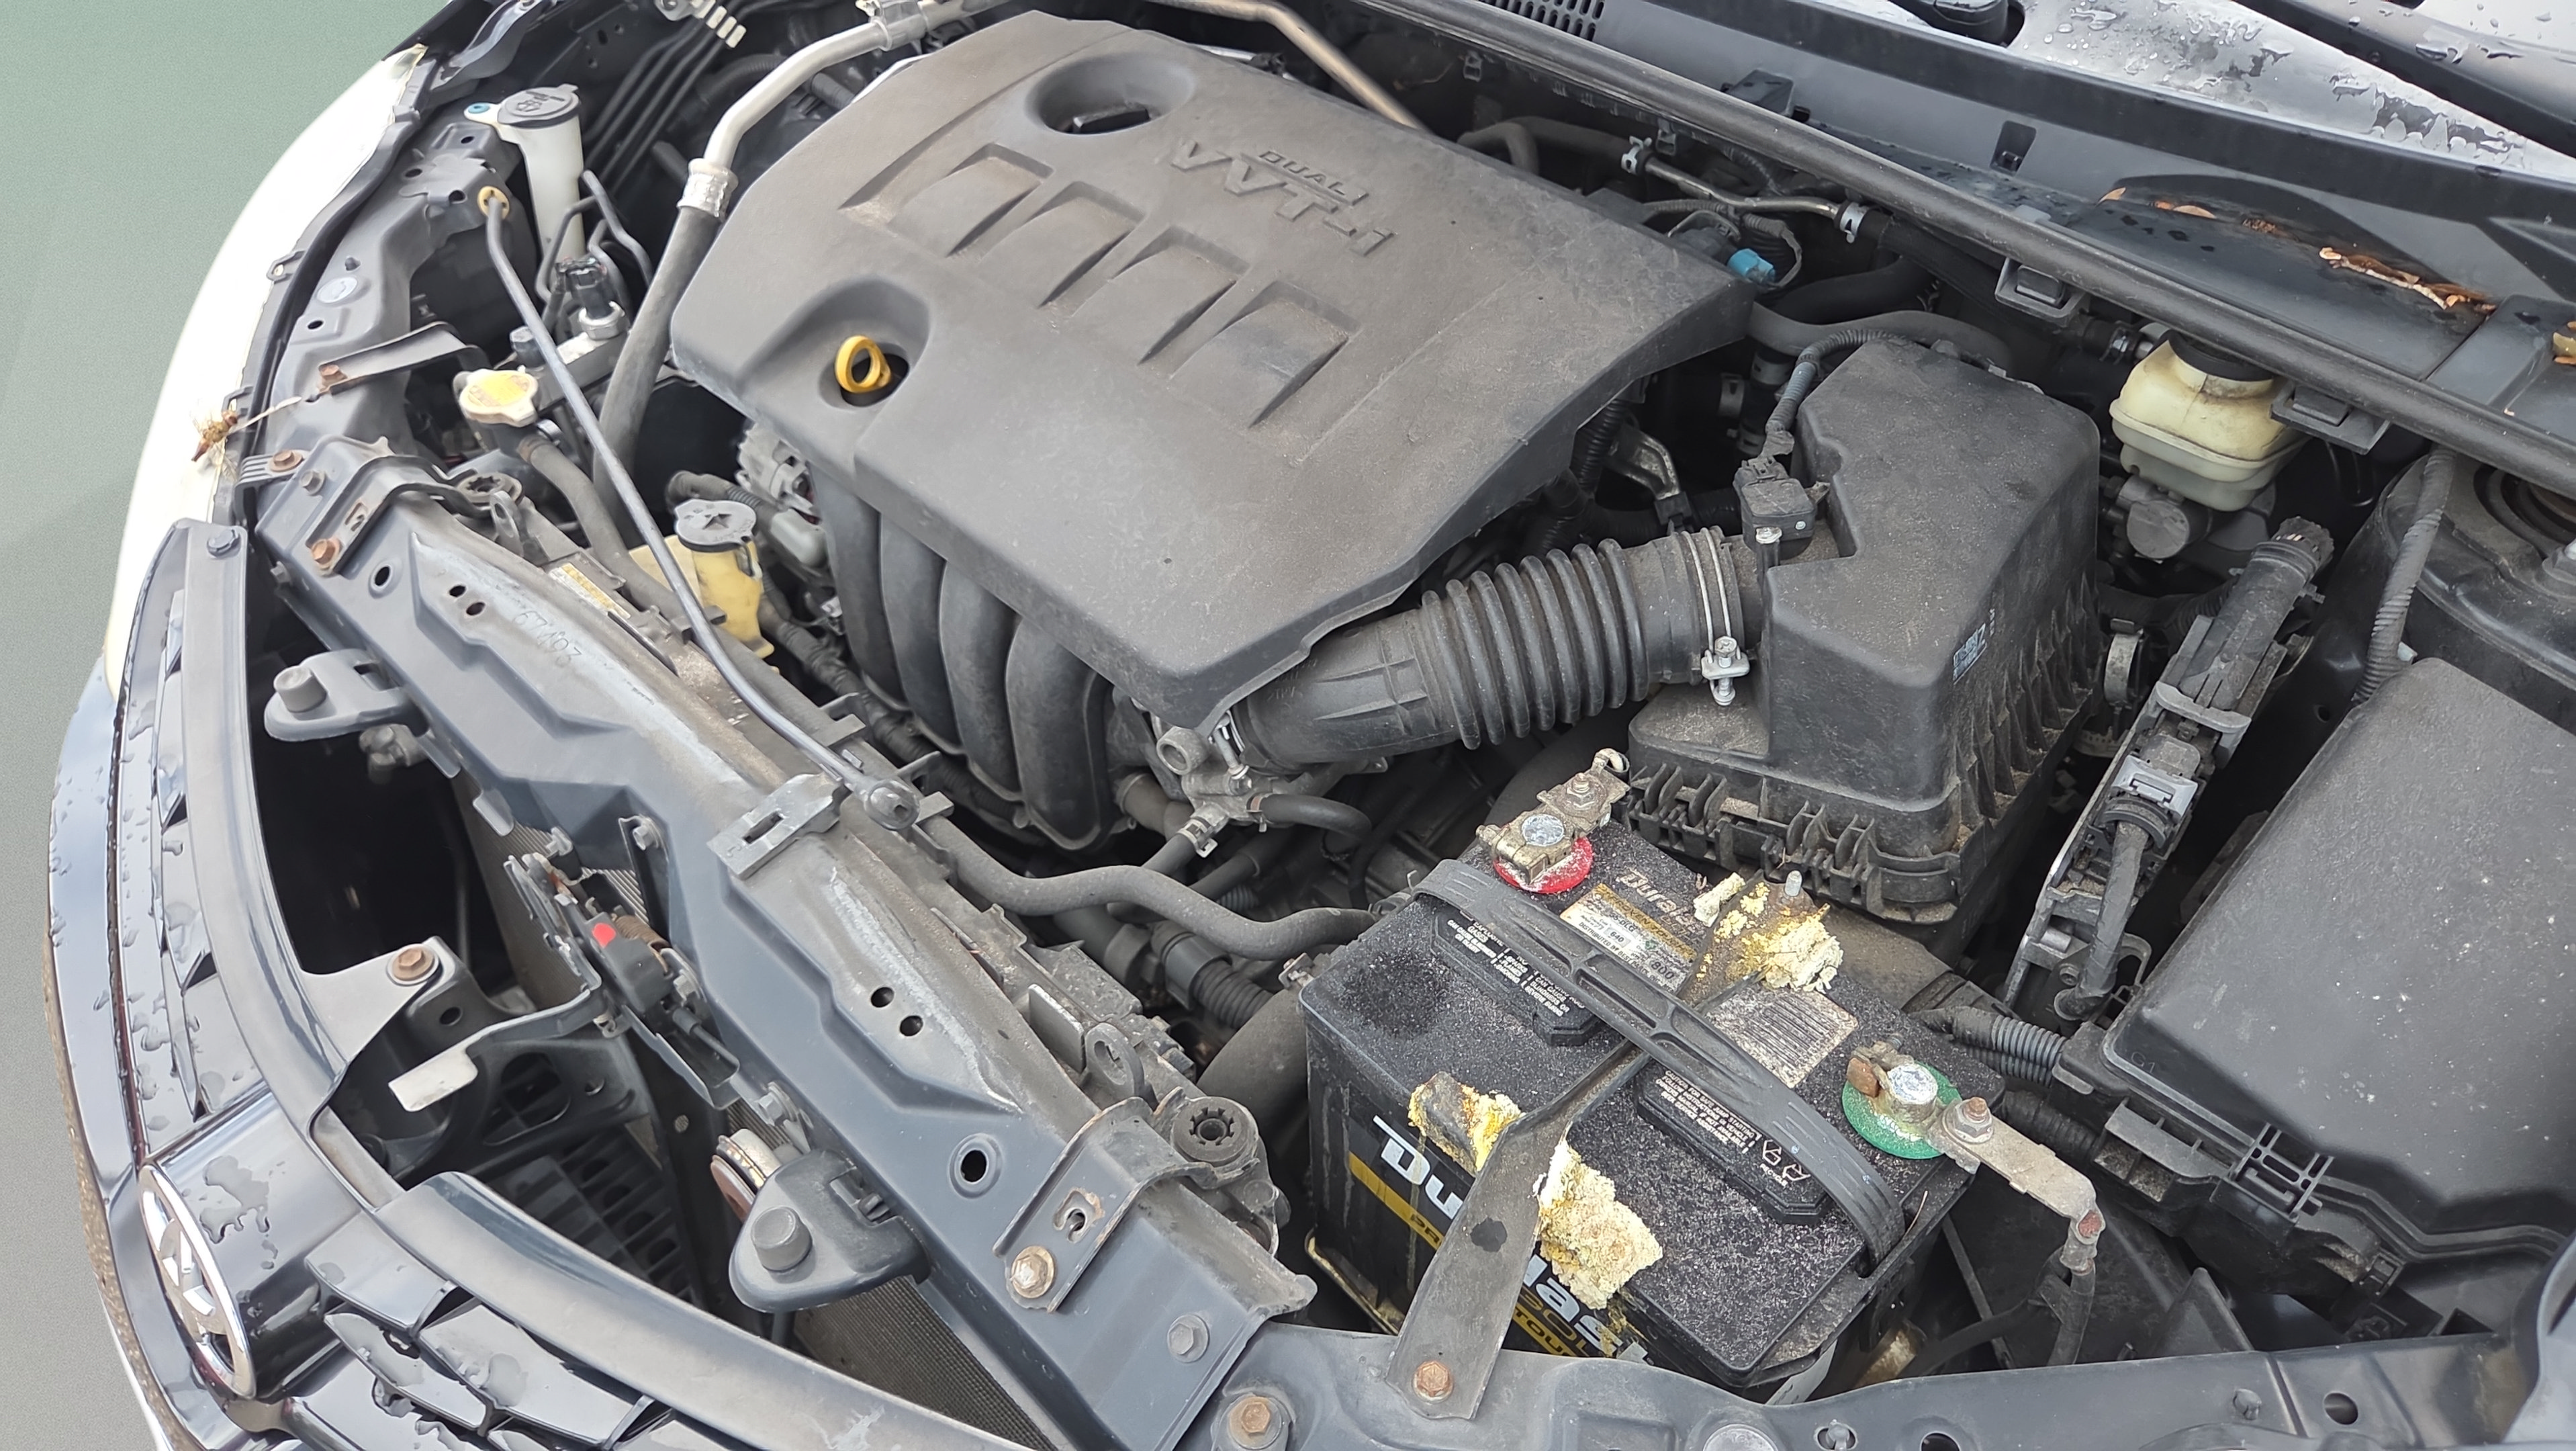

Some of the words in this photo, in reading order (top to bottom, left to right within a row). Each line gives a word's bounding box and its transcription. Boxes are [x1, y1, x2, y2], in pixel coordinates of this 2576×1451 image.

[1259, 150, 1346, 195] DUAL
[1466, 924, 1488, 943] GASES
[1579, 922, 1612, 949] DISTRIBUTED
[1610, 932, 1624, 943] 640
[1651, 960, 1674, 979] 800
[1524, 985, 1546, 1002] SEVERE
[1543, 1000, 1563, 1016] BURNS
[1530, 981, 1560, 1005] BLINDNESS
[1559, 1003, 1570, 1012] OR
[1534, 977, 1548, 987] CAN
[1546, 985, 1566, 1002] CAUSE
[1661, 1091, 1675, 1104] SEEK
[1674, 1102, 1697, 1119] SERVICE
[1662, 1075, 1684, 1095] FOLLOW
[1683, 1089, 1720, 1120] INSTRUCTIONS
[1725, 1123, 1749, 1141] VEHICLE
[1688, 1088, 1700, 1098] FOR
[1700, 1095, 1714, 1108] SAFE
[1713, 1107, 1729, 1118] JUMP
[1729, 1117, 1755, 1138] STARTING
[1705, 1116, 1718, 1127] NOT
[1718, 1123, 1746, 1148] AVAILABLE
[1759, 1163, 1788, 1187] RECYCLE
